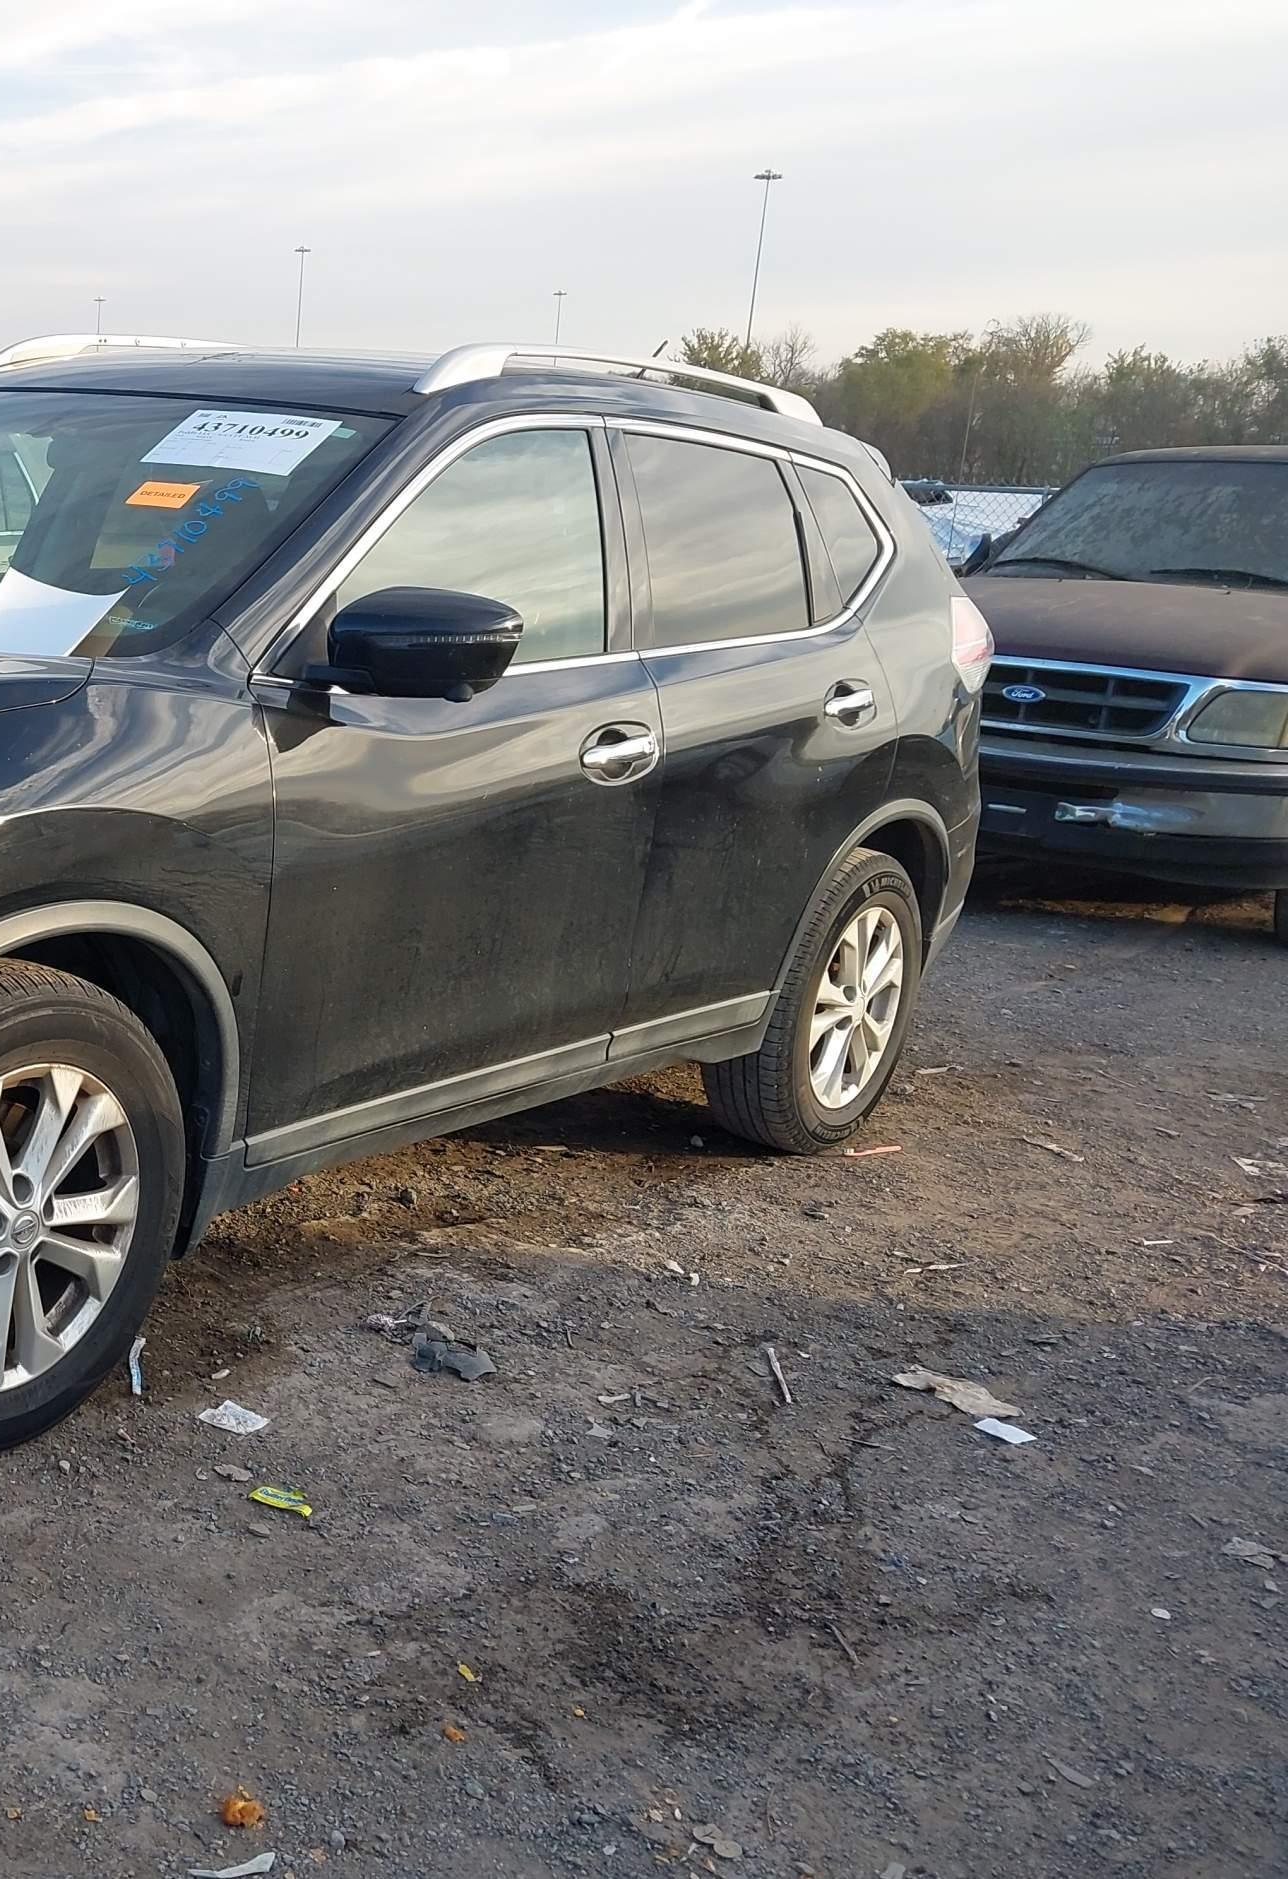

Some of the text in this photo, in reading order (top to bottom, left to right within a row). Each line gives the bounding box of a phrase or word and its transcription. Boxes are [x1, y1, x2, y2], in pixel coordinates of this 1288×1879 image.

[193, 420, 310, 440] 43710499
[140, 490, 186, 499] DETAILED
[1011, 688, 1035, 699] Ford
